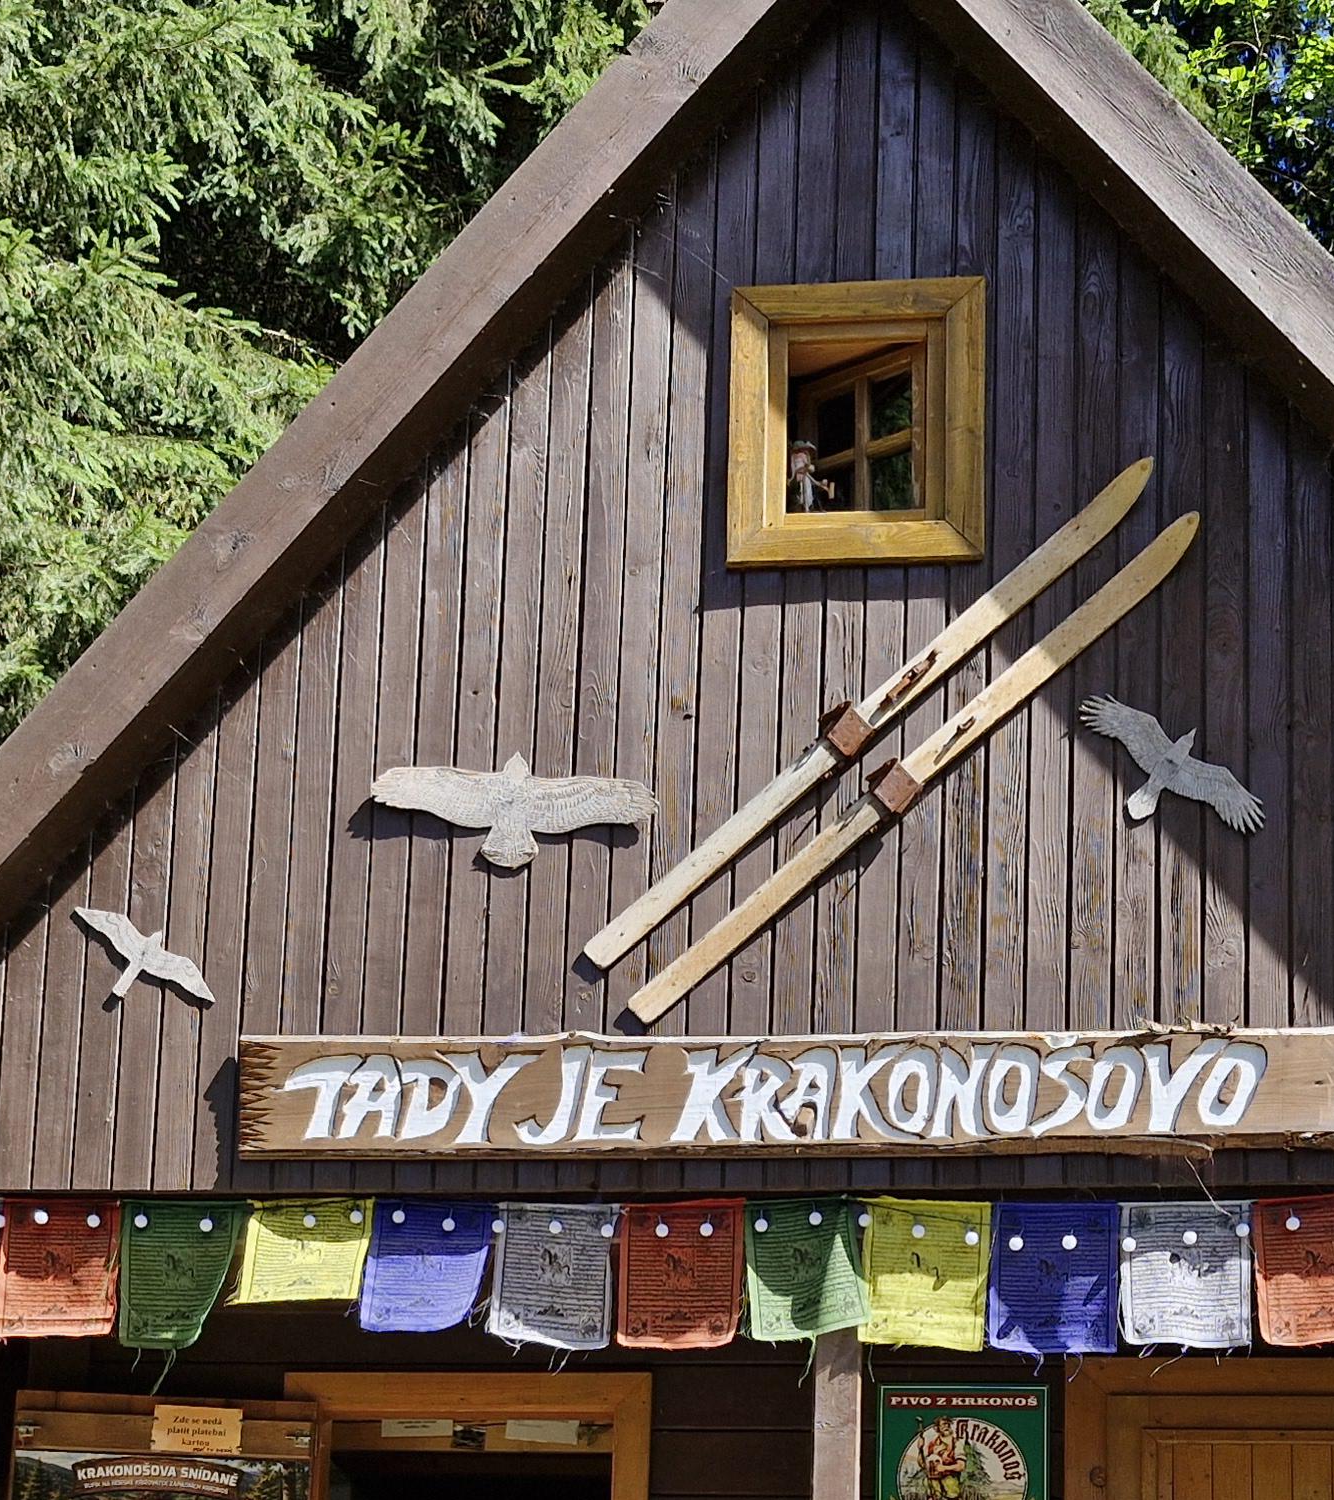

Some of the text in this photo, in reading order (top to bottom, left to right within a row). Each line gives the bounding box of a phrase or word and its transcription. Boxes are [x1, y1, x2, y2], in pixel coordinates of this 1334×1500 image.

[283, 1050, 541, 1145] TADY
[515, 1045, 646, 1144] JE
[890, 1395, 1038, 1407] PIVO Z KRKONOŠ
[173, 1416, 189, 1425] Zde
[202, 1417, 223, 1425] nedá
[167, 1426, 190, 1436] platit
[181, 1438, 210, 1447] kartou
[77, 1463, 239, 1487] KRAKONOŠOVA SNÍDANĚ
